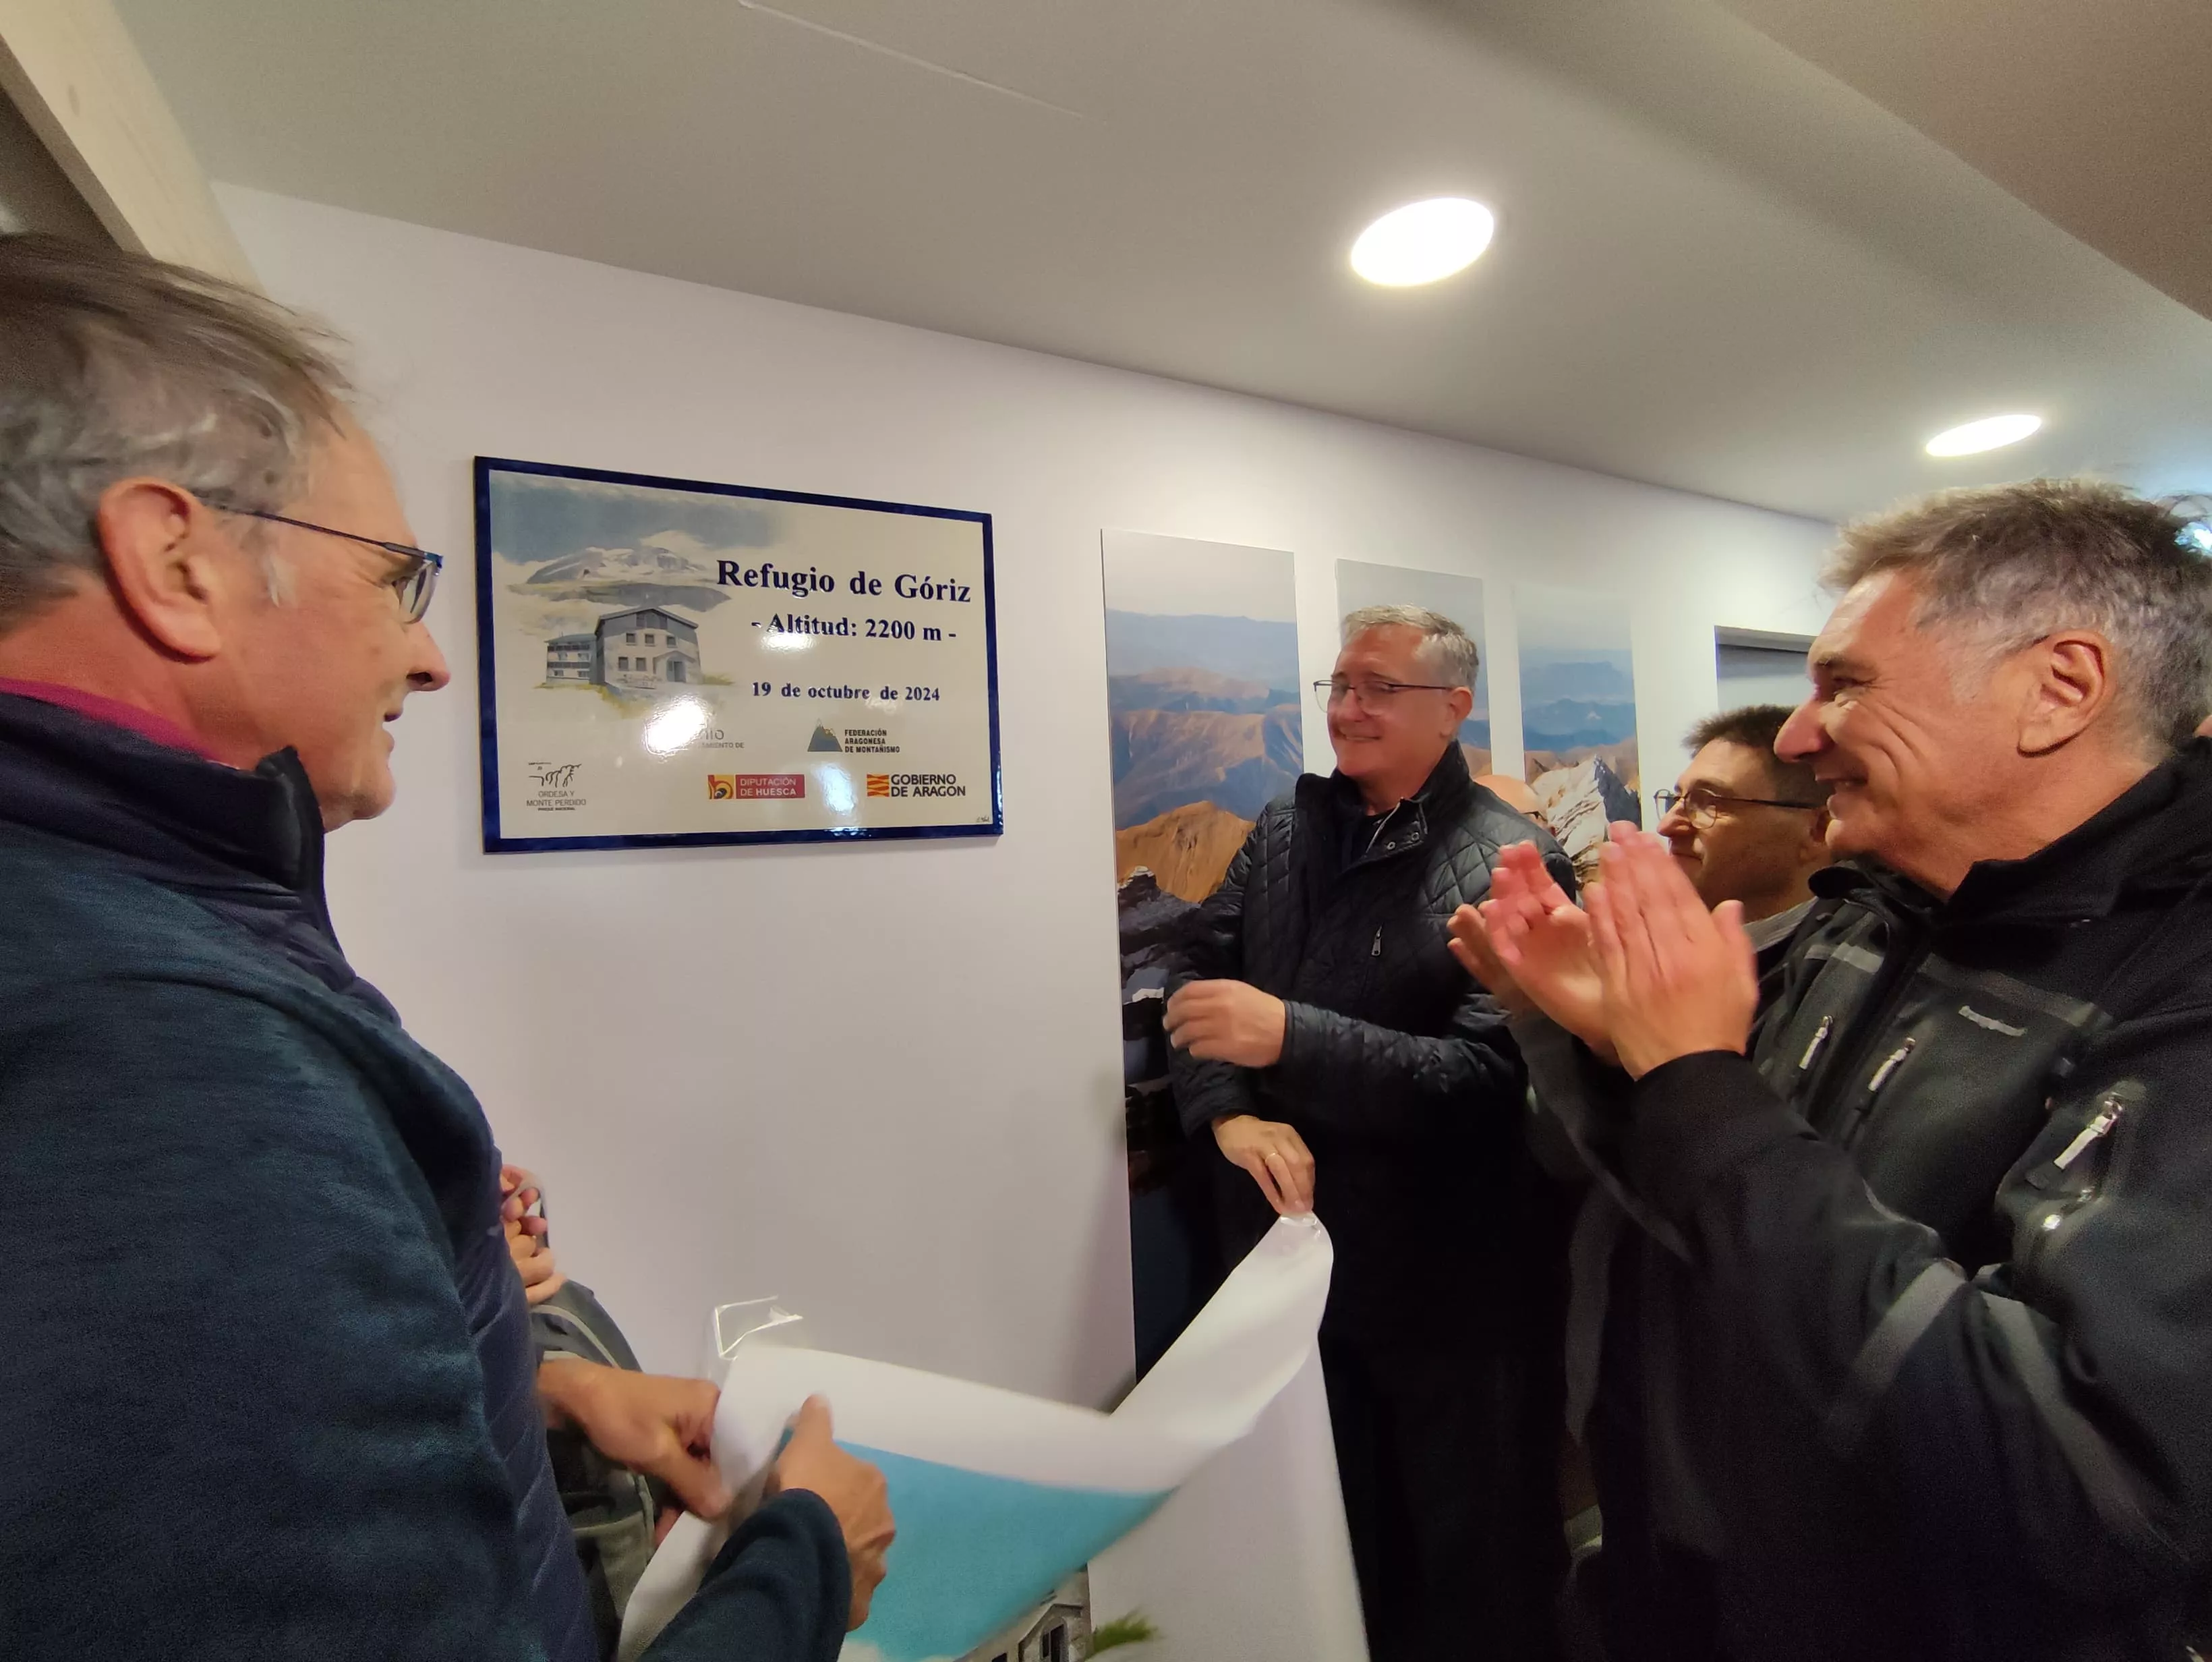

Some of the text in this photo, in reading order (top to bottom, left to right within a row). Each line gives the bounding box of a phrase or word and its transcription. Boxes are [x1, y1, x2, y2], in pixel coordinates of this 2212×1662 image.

[717, 560, 971, 602] Refugio de Góriz
[766, 613, 857, 636] Altitud:
[865, 619, 915, 639] 2200
[923, 625, 941, 641] m
[752, 682, 940, 701] 19 de octubre de 2024
[844, 728, 887, 737] FEDERACIÓN
[856, 744, 900, 753] MONTAÑISMO
[740, 777, 796, 786] DIPUTACIÓN
[891, 774, 956, 785] GOBIERNO
[740, 788, 796, 797] DE HUESCA
[891, 786, 908, 797] DE
